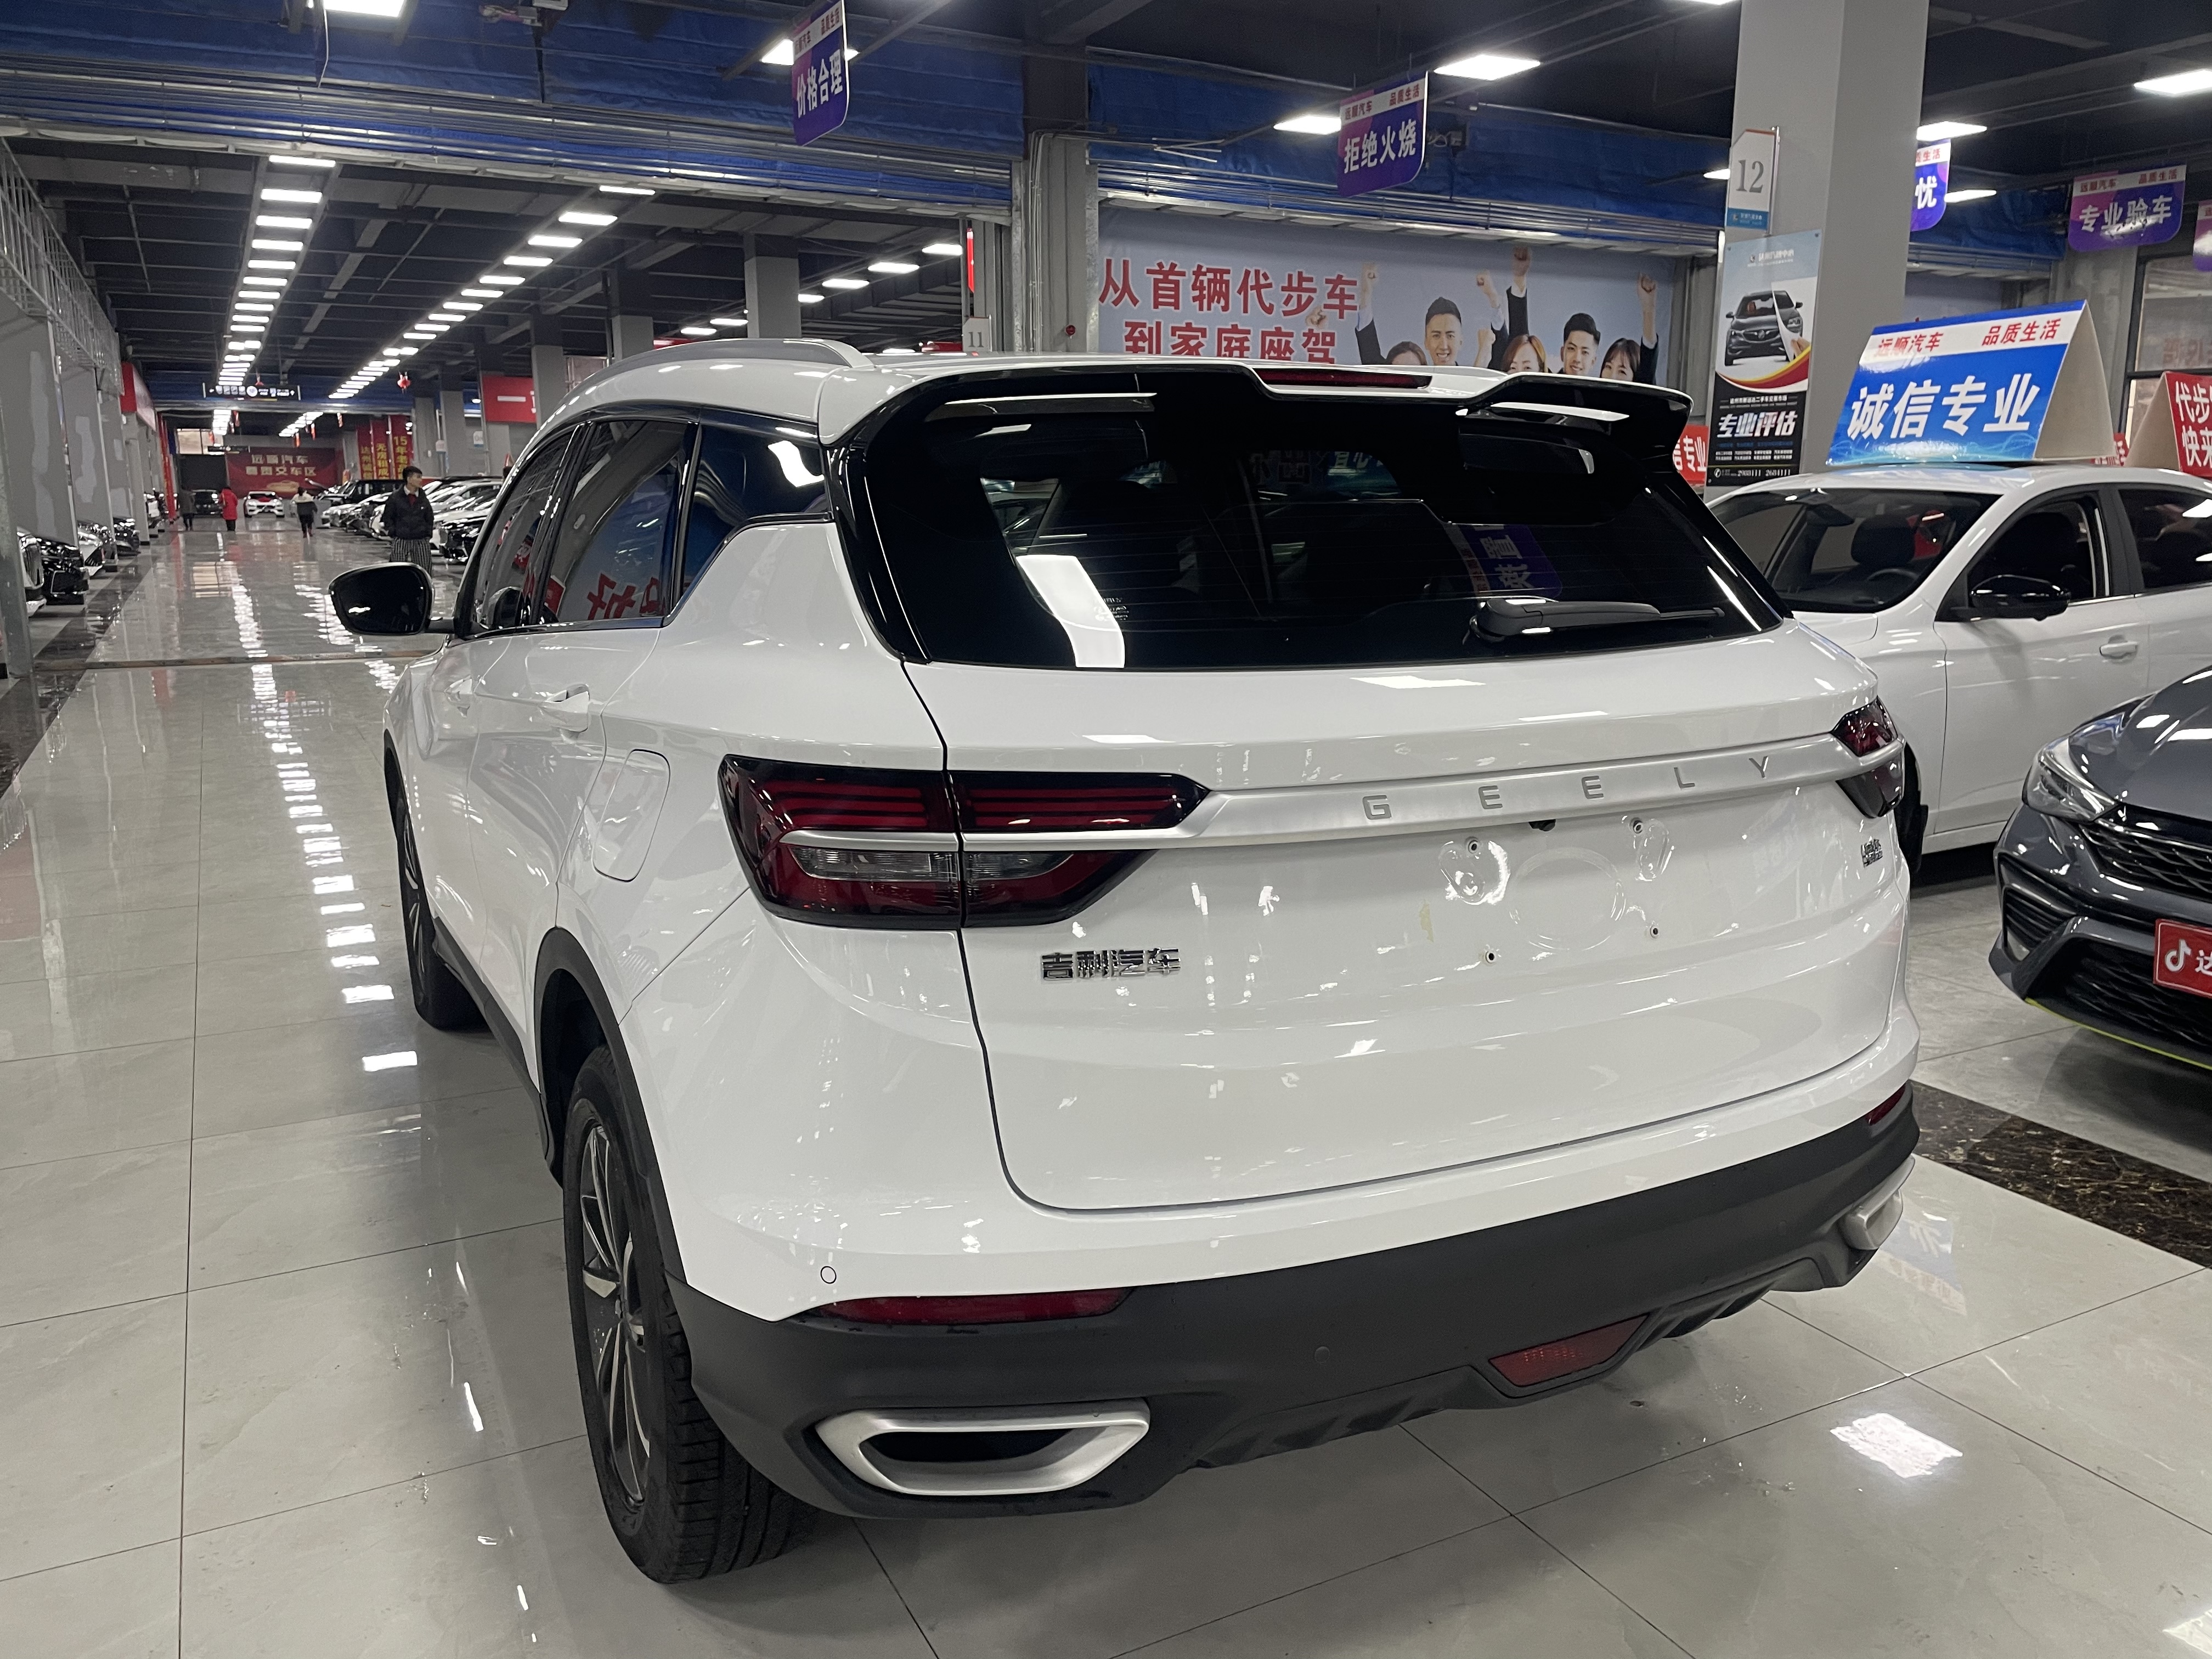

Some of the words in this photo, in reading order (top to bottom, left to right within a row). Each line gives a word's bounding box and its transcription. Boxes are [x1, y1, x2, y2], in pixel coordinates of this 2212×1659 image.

[797, 49, 843, 119] 价格合理
[1389, 83, 1419, 106] 品质生活
[1344, 119, 1417, 174] 拒绝火烧
[1736, 159, 1764, 194] 12
[1915, 176, 1938, 210] 忧
[2079, 195, 2172, 233] 专业验车
[1098, 258, 1358, 320] 从首辆代步车
[968, 331, 985, 348] 11
[1124, 320, 1336, 364] 到家庭座驾
[1876, 332, 1944, 357] 远顺汽车
[1982, 318, 2061, 346] 品质生活
[1847, 373, 2040, 441] 诚信专业
[2175, 380, 2212, 424] 代步
[1717, 410, 1798, 438] 专业评估
[1362, 755, 1770, 821] GEELY
[1041, 948, 1181, 980] 吉利汽车
